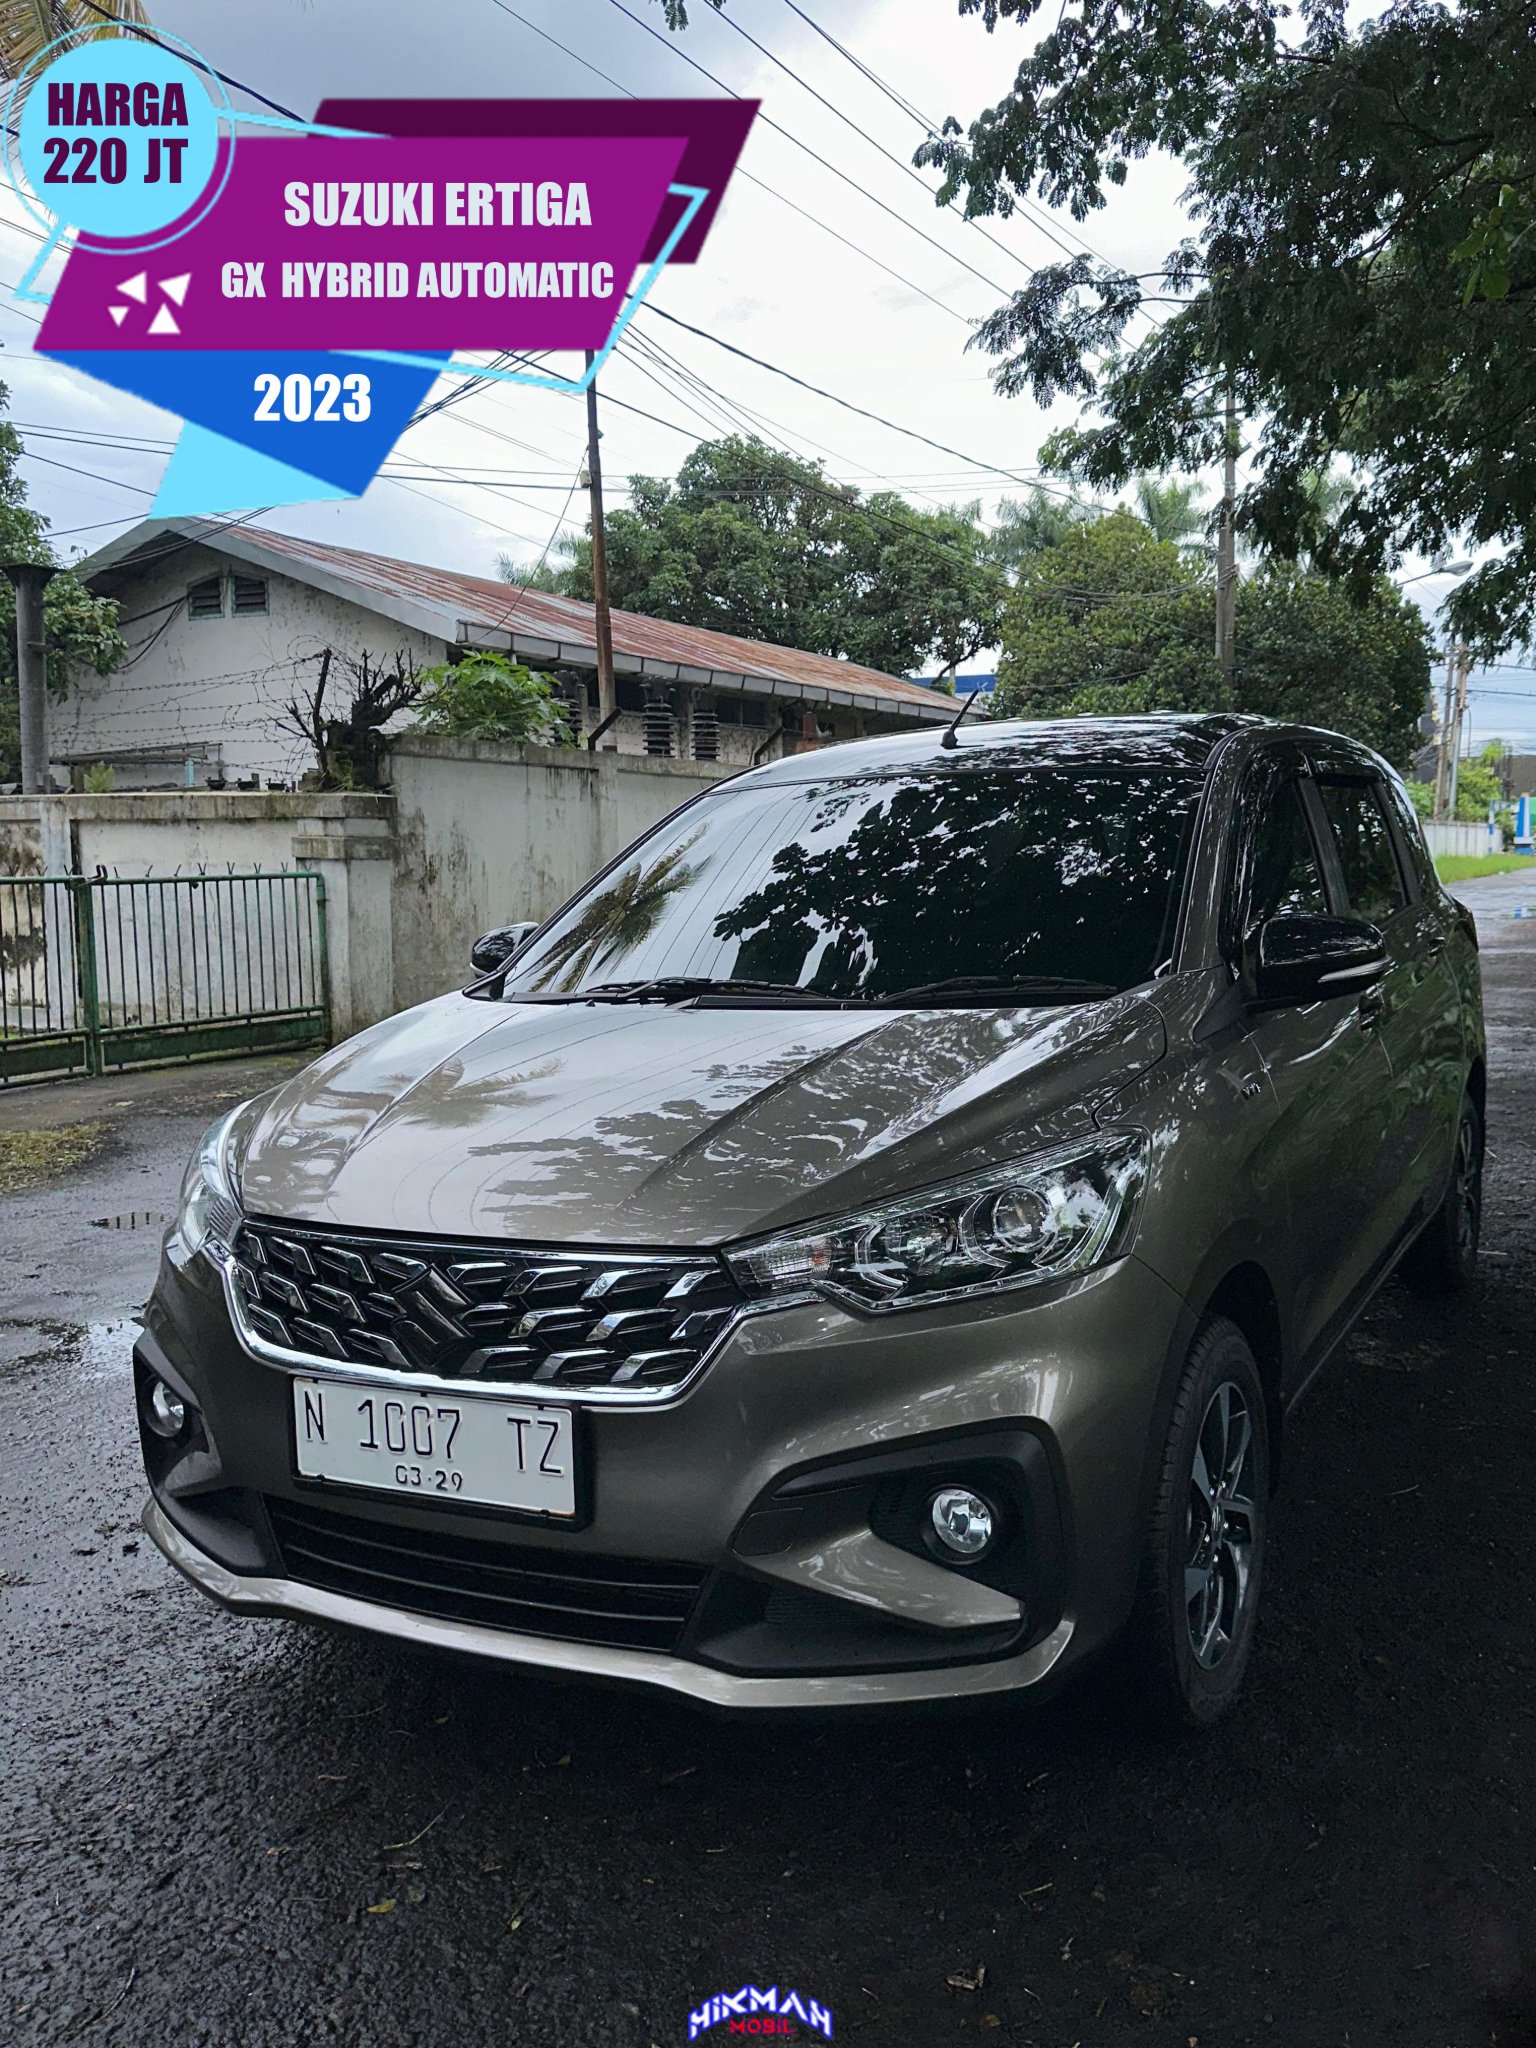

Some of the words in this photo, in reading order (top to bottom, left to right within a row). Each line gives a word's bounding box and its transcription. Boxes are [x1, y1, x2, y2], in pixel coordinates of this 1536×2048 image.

[304, 1390, 326, 1442] N
[358, 1399, 461, 1459] 1007
[507, 1416, 563, 1474] TZ
